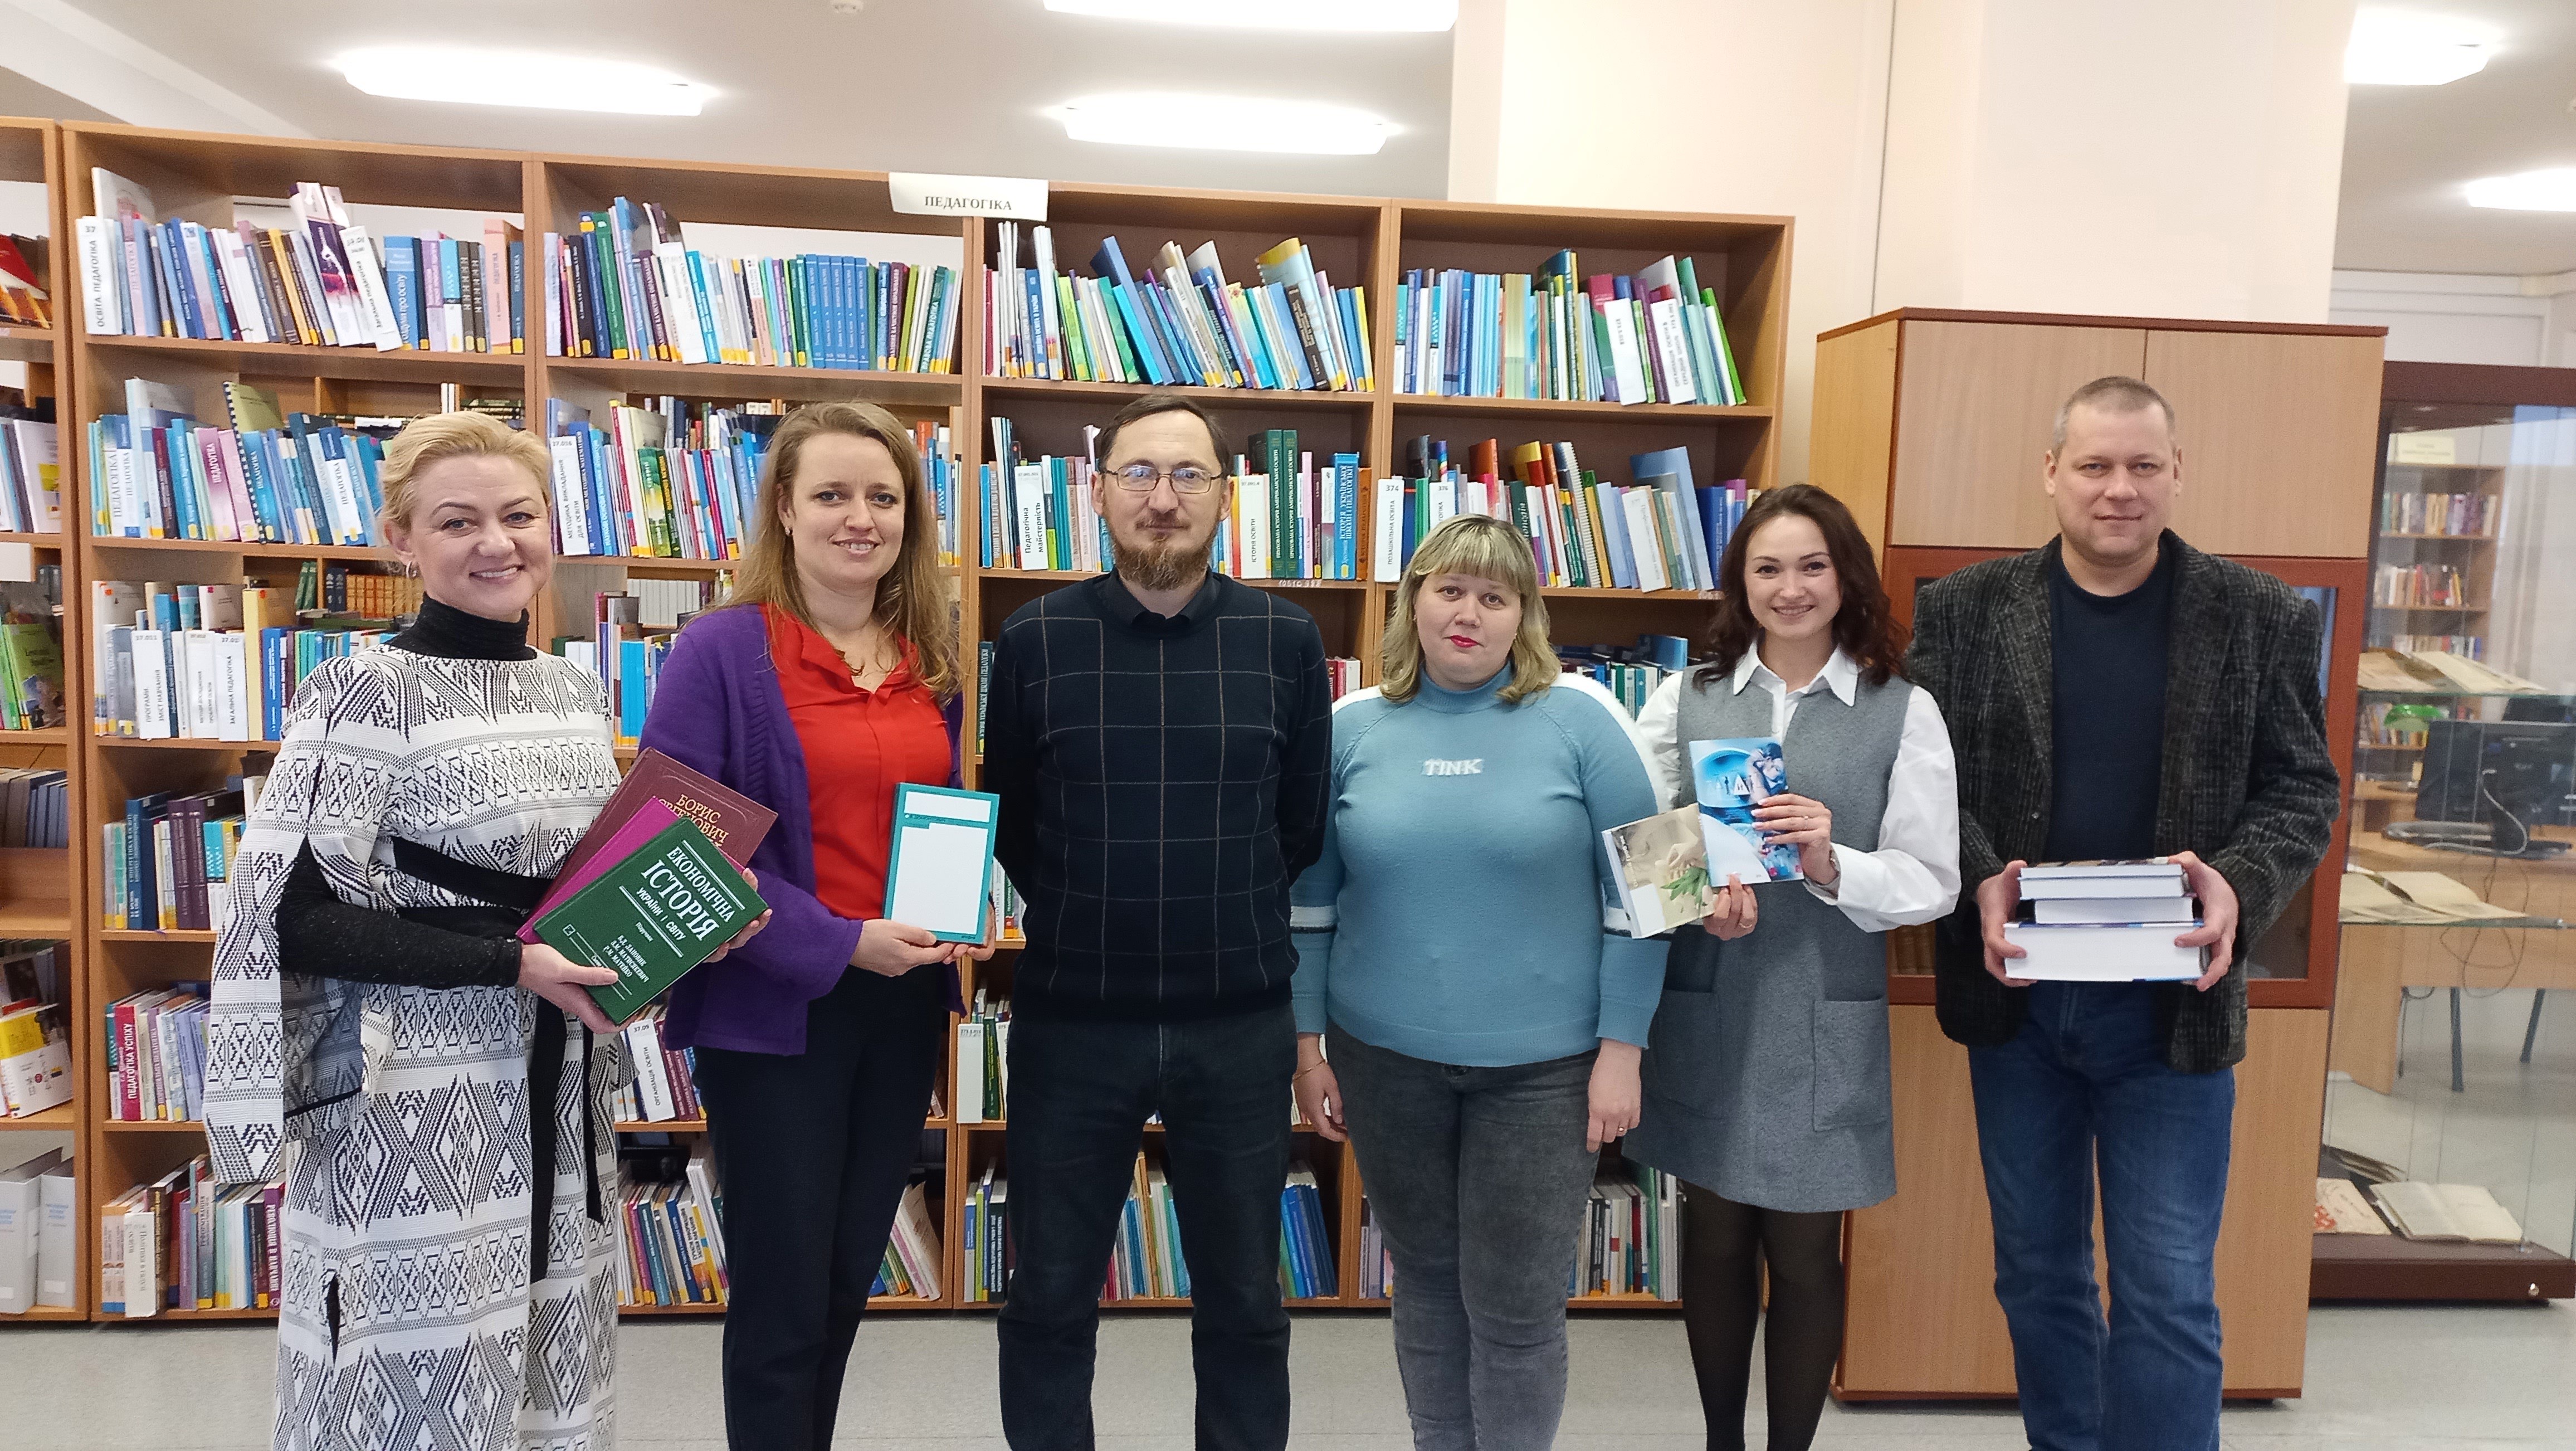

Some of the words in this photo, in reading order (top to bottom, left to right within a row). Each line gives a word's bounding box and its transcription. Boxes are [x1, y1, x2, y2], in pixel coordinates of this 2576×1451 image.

[924, 195, 1012, 212] ПЕДАГОГІКА
[89, 240, 101, 292] ПЕДАГОГІКА
[369, 299, 382, 328] Загальна
[1665, 327, 1674, 347] ОСВІТИ
[123, 452, 133, 496] ПЕДАГОГІКА
[206, 443, 222, 483] ПЕДАГОГІКА
[250, 451, 264, 489] ПЕДАГОГІКА
[333, 462, 349, 504] ПЕДАГОГІКА
[558, 459, 569, 501] ВИКЛАДАННЯ
[108, 454, 122, 518] ПЕДАГОГІКА
[1339, 465, 1347, 508] УКРАЇНСЬКОЇ
[564, 504, 574, 539] МЕТОДИКА
[1023, 508, 1032, 553] Педагогічна
[1035, 503, 1044, 553] майстерність
[154, 669, 163, 702] НАВЧАННЯ
[1424, 758, 1483, 775] TINK
[676, 794, 721, 824] БОРИС
[641, 859, 719, 941] ІСТОРІЯ
[667, 846, 735, 922] ЕКОНОМІЧНА
[636, 887, 663, 916] УКРАЇНИ
[666, 922, 686, 941] СВІТУ
[124, 1023, 133, 1050] УСПІХУ
[634, 1024, 650, 1033] 37.09
[126, 1052, 137, 1099] ПЕДАГОГІКА
[643, 1046, 652, 1068] ОСВІТИ
[648, 1069, 661, 1106] ОРГАНІЗАЦІЯ
[266, 1205, 277, 1247] РЕВОЛЮЦІЯ
[270, 1256, 279, 1292] НАВЧАННІ
